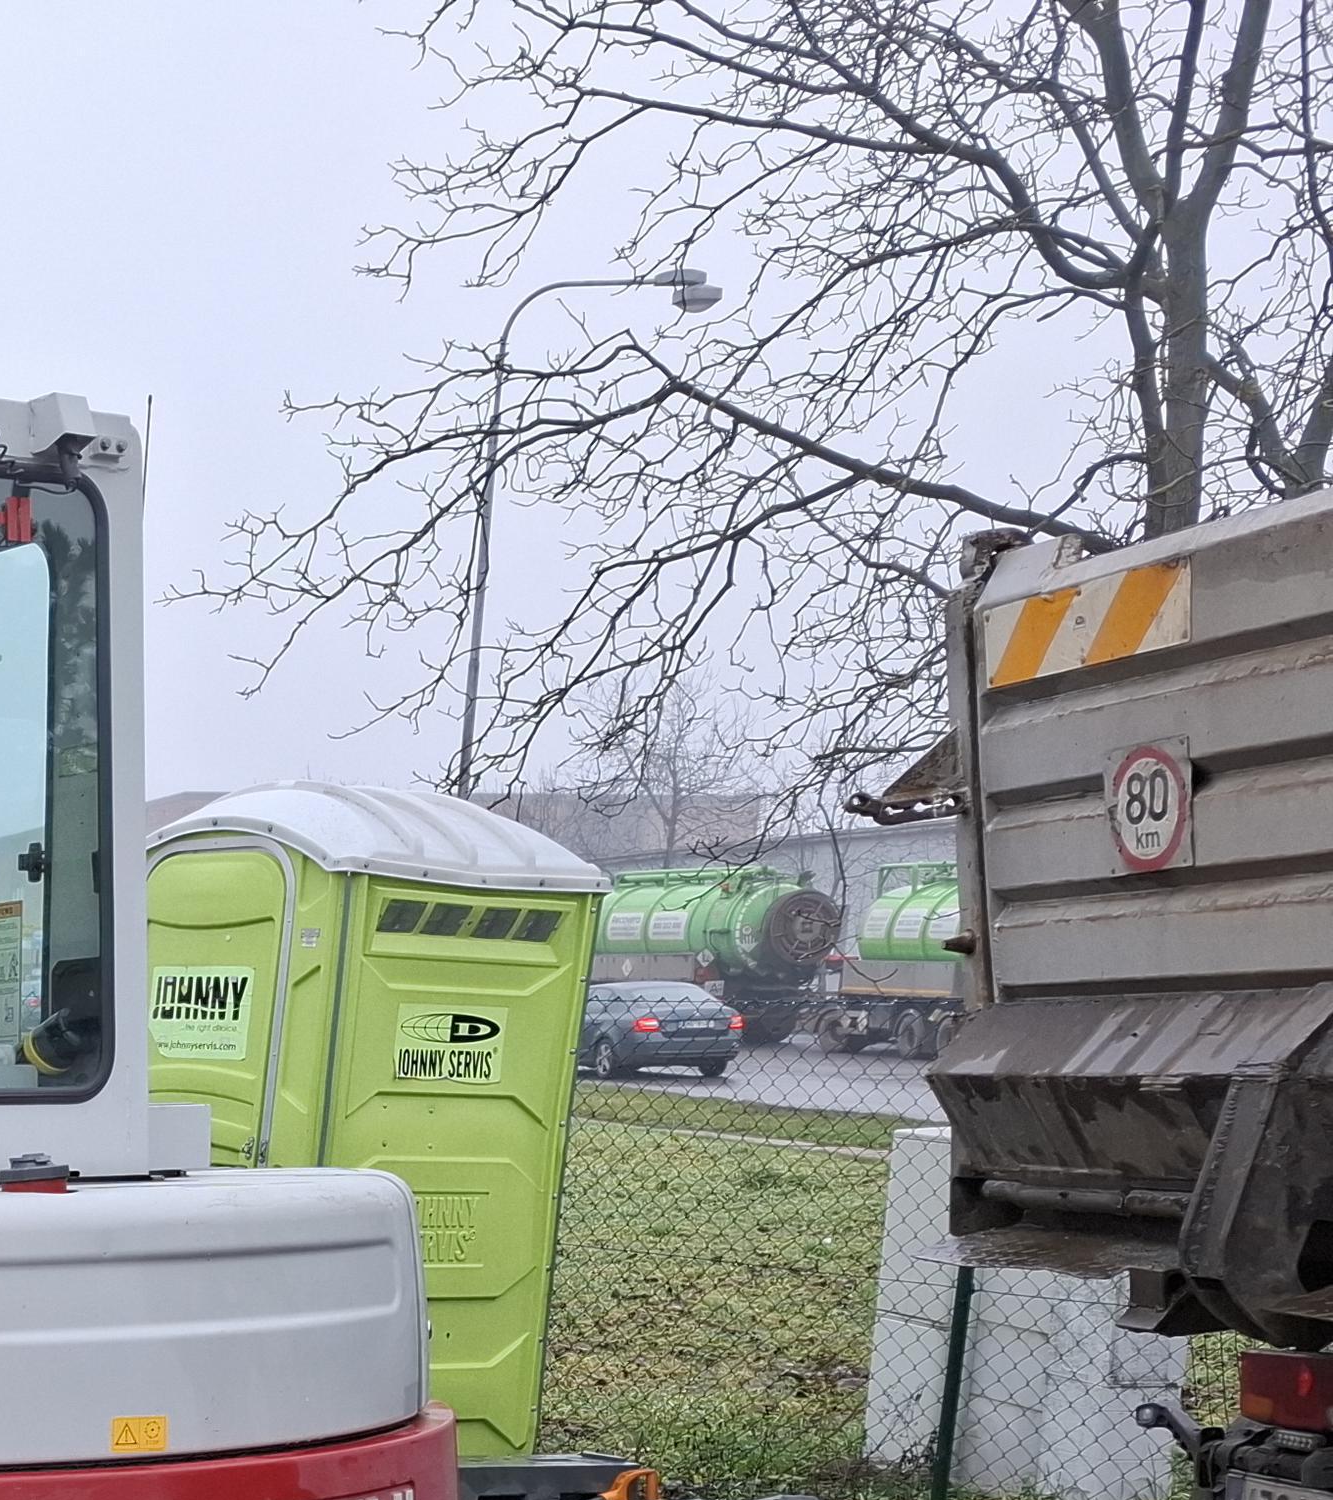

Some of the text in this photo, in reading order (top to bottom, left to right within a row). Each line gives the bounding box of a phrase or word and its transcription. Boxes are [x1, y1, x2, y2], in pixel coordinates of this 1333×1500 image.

[1126, 768, 1169, 825] 80
[1135, 827, 1161, 850] km
[152, 976, 249, 1021] JOHNNY
[448, 1049, 492, 1079] SERVIS
